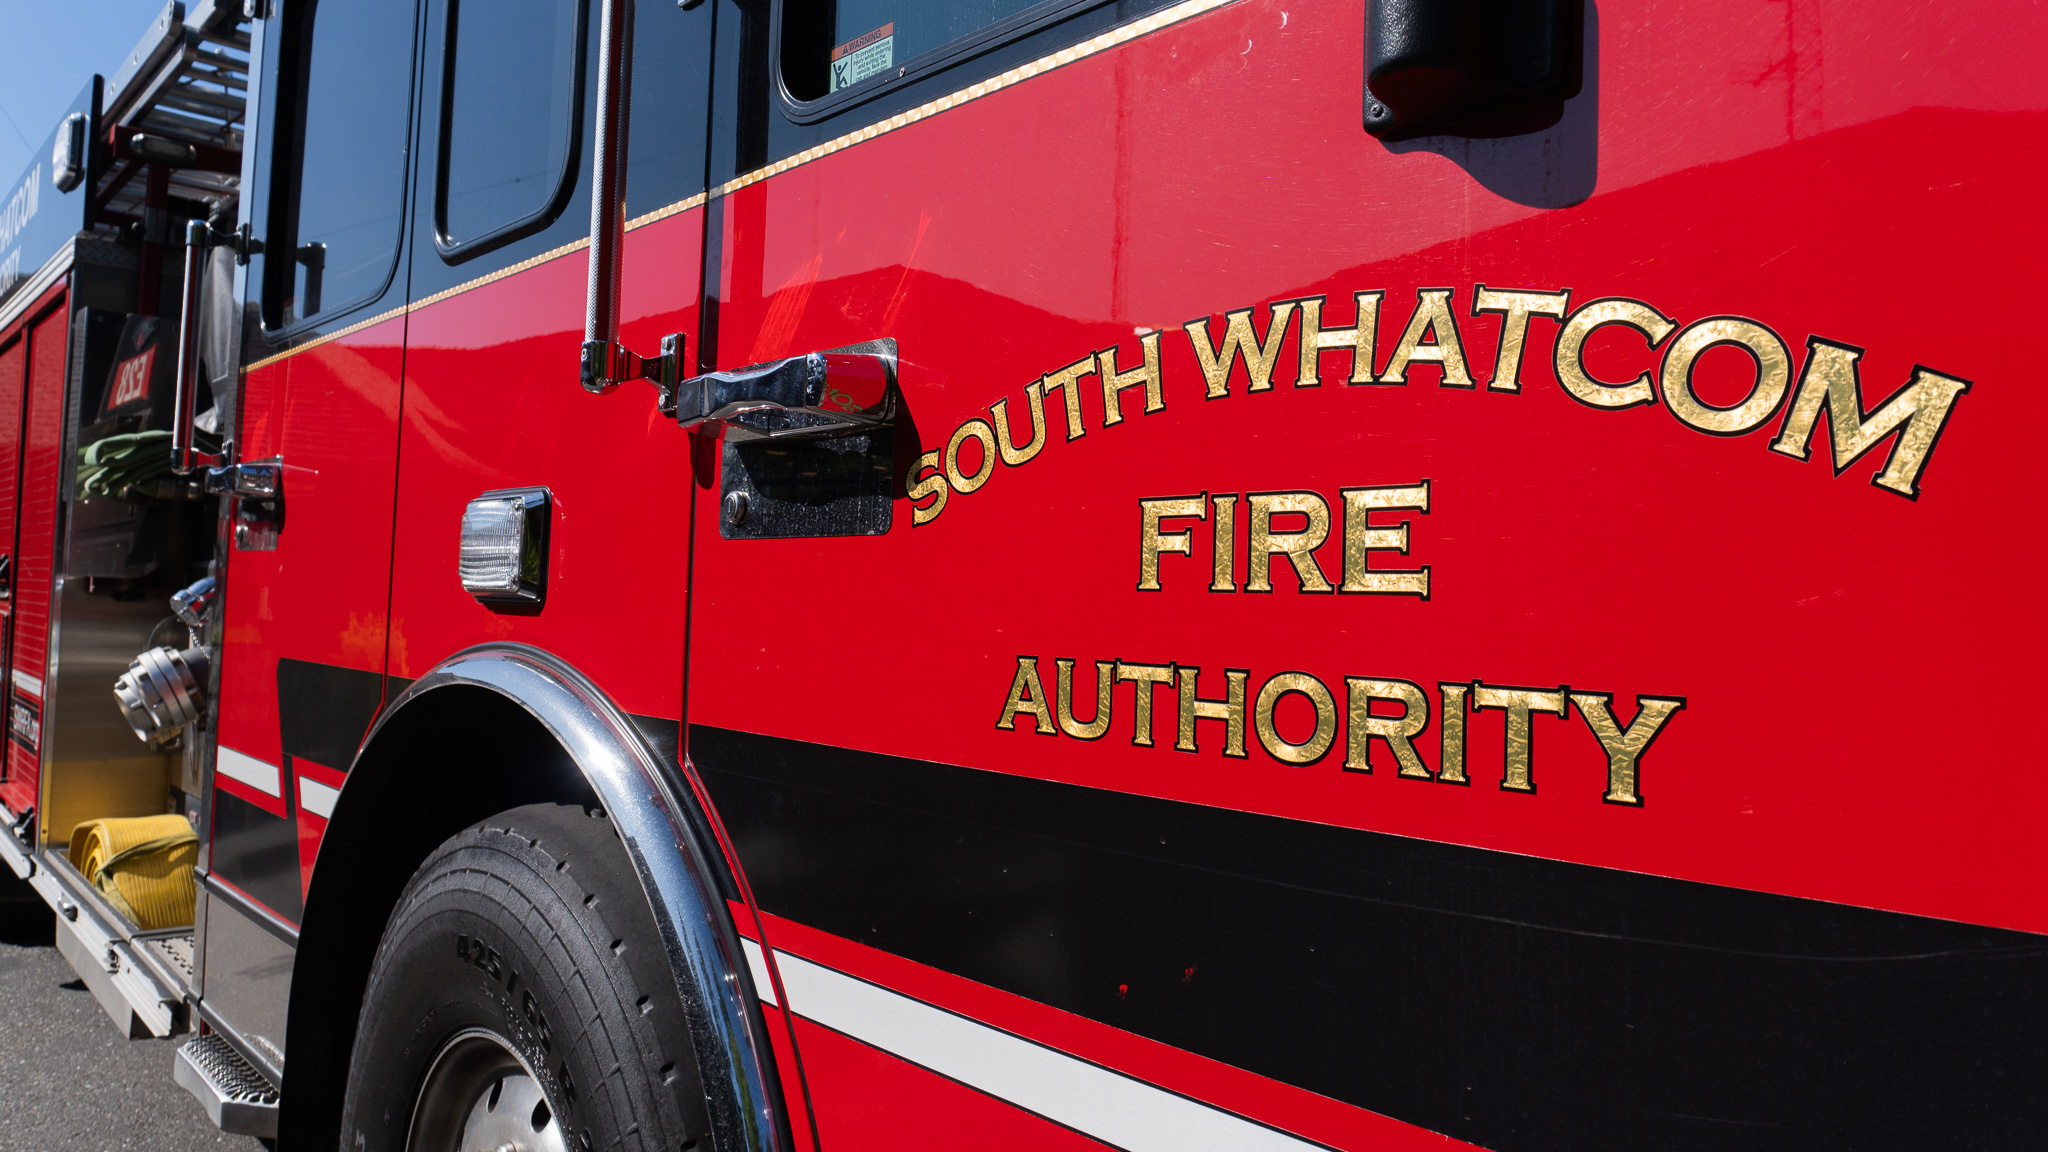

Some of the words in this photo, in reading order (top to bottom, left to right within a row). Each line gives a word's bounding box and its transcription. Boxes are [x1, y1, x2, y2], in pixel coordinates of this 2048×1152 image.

[849, 29, 882, 52] WARNING
[905, 329, 1166, 529] SOUTH
[1182, 283, 1974, 502] WHATCOM
[1136, 478, 1432, 601] FIRE
[996, 654, 1688, 808] AUTHORITY
[457, 933, 502, 983] 425
